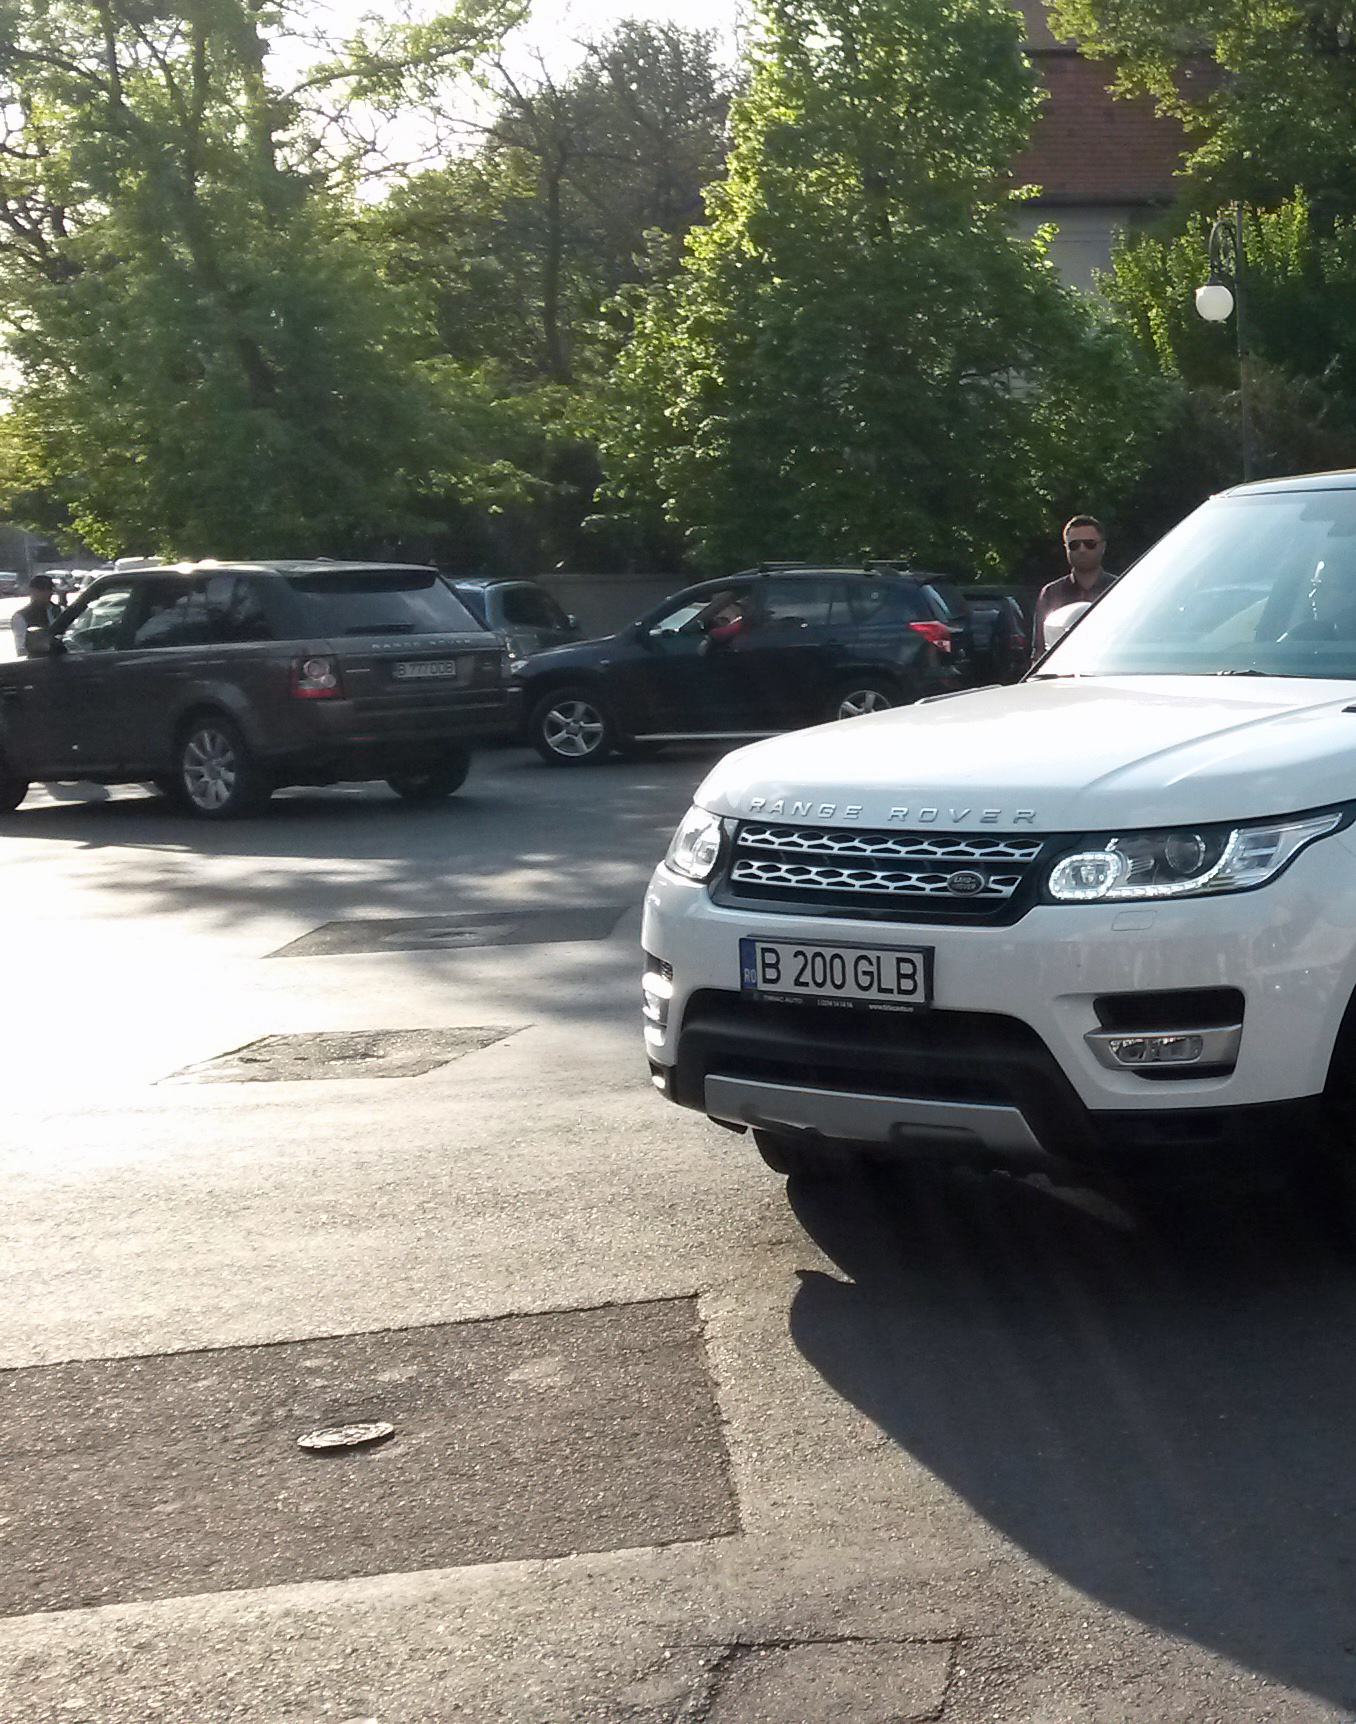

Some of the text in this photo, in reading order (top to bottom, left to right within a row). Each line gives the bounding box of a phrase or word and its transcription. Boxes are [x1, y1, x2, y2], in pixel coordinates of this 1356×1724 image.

[749, 797, 1038, 824] RANGE ROVER
[744, 968, 758, 983] RO
[761, 946, 919, 996] B 200 GLB
